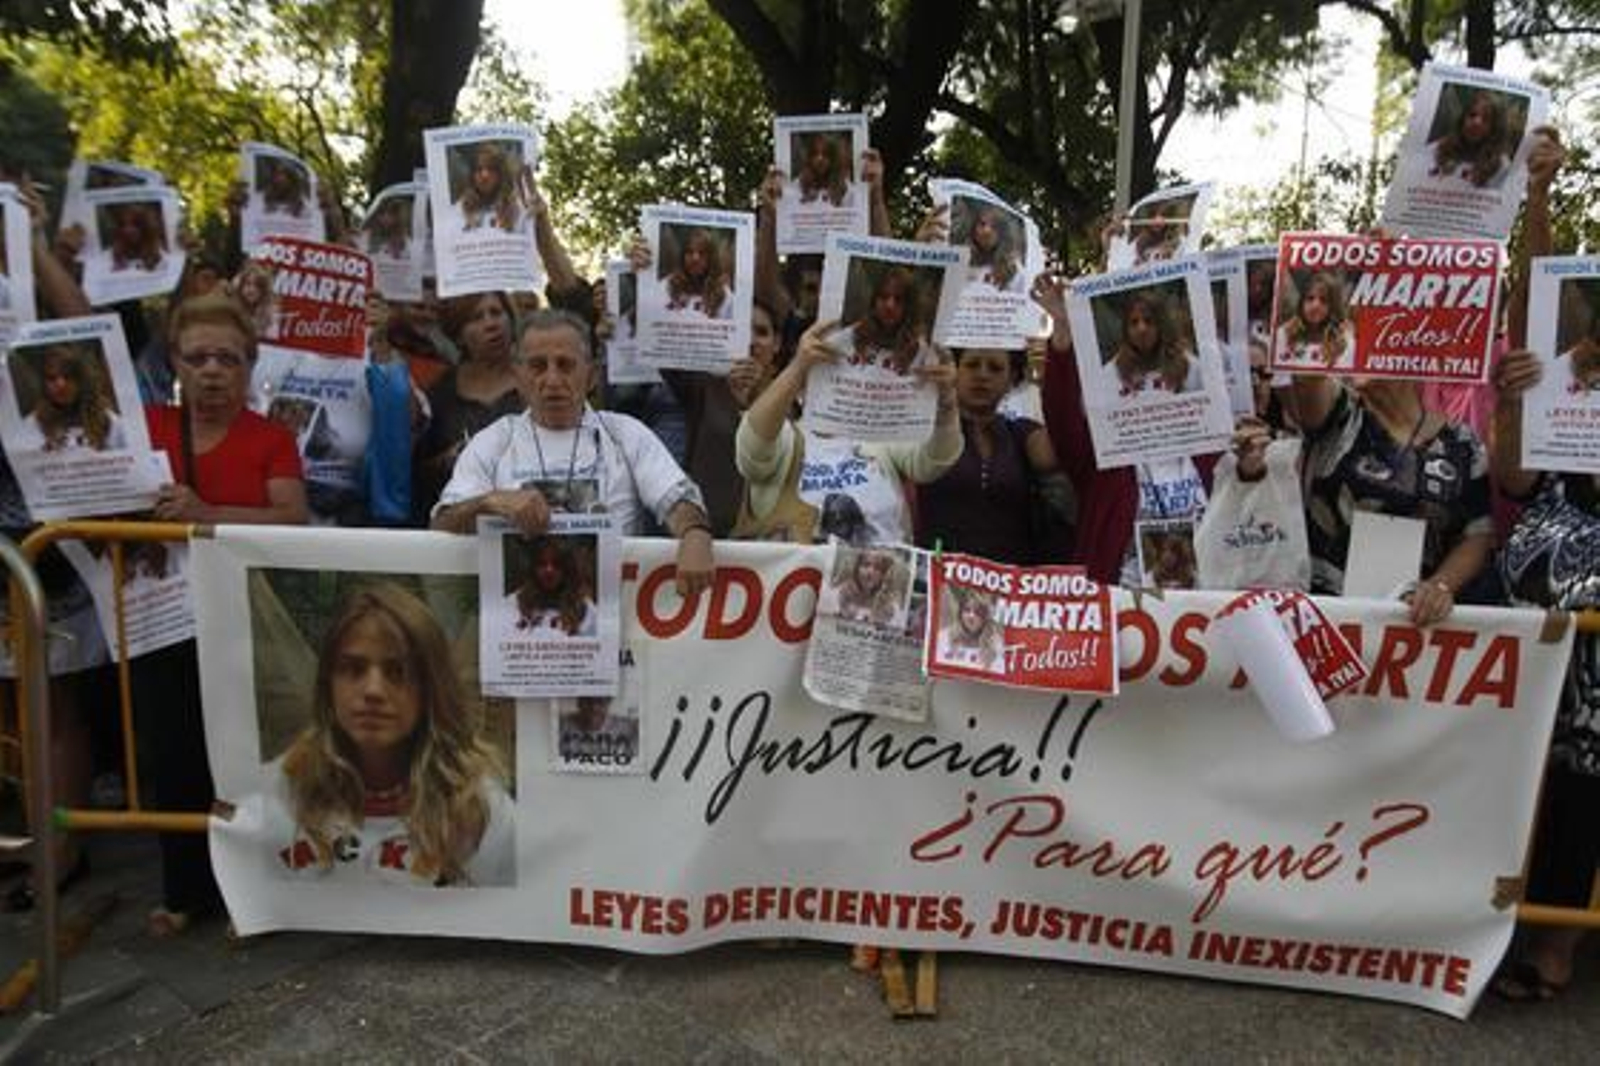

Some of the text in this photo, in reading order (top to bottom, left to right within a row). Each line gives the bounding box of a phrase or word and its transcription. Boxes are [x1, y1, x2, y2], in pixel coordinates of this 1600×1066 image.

[299, 249, 368, 278] SOMOS
[1289, 241, 1381, 266] TODOS
[1388, 243, 1494, 267] SOMOS
[273, 269, 367, 310] MARTA
[1349, 272, 1490, 309] MARTA
[274, 307, 364, 339] Todos!!
[1376, 310, 1482, 348] Todos!!
[1365, 354, 1438, 371] JUSTICIA
[801, 473, 869, 492] MARTA
[943, 561, 1099, 597] TODOS SOMOS
[621, 563, 823, 644] ODO
[993, 598, 1103, 632] MARTA
[1004, 636, 1100, 672] Todos!!
[562, 732, 635, 752] PARA
[563, 752, 633, 766] PACO
[910, 791, 1429, 923] ¿Para qué?
[570, 887, 1471, 996] LEYES DEFICIENTES, JUSTICIA INEXISTENTE
